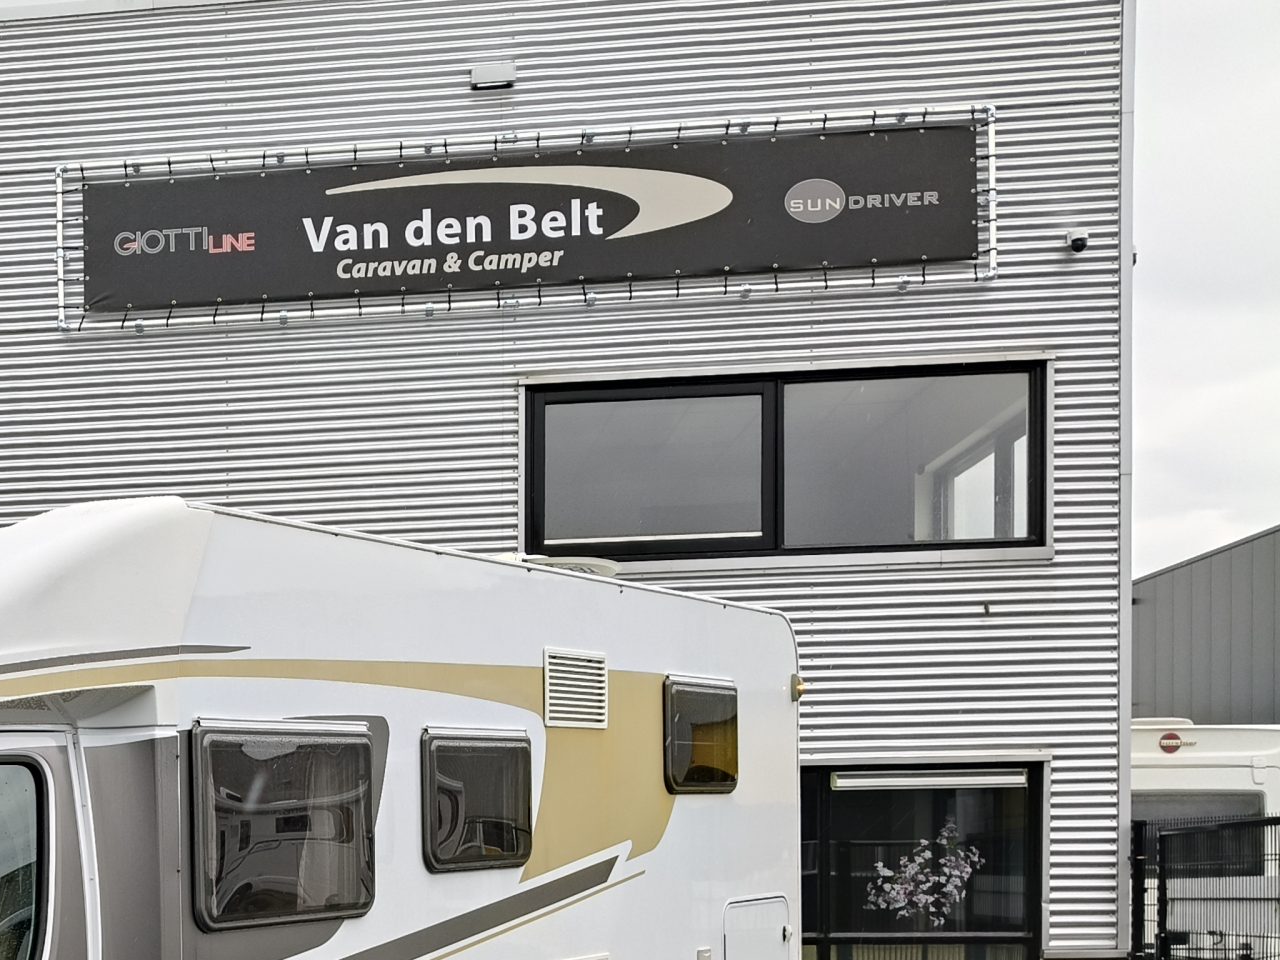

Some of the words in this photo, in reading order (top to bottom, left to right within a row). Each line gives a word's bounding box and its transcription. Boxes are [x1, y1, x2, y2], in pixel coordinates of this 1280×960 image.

[789, 197, 841, 212] SUN
[848, 191, 940, 210] DRIVER
[301, 216, 390, 253] Van
[404, 208, 492, 247] den
[509, 198, 604, 241] Belt
[336, 258, 438, 280] Caravan
[442, 252, 462, 273] &
[467, 249, 565, 273] Camper
